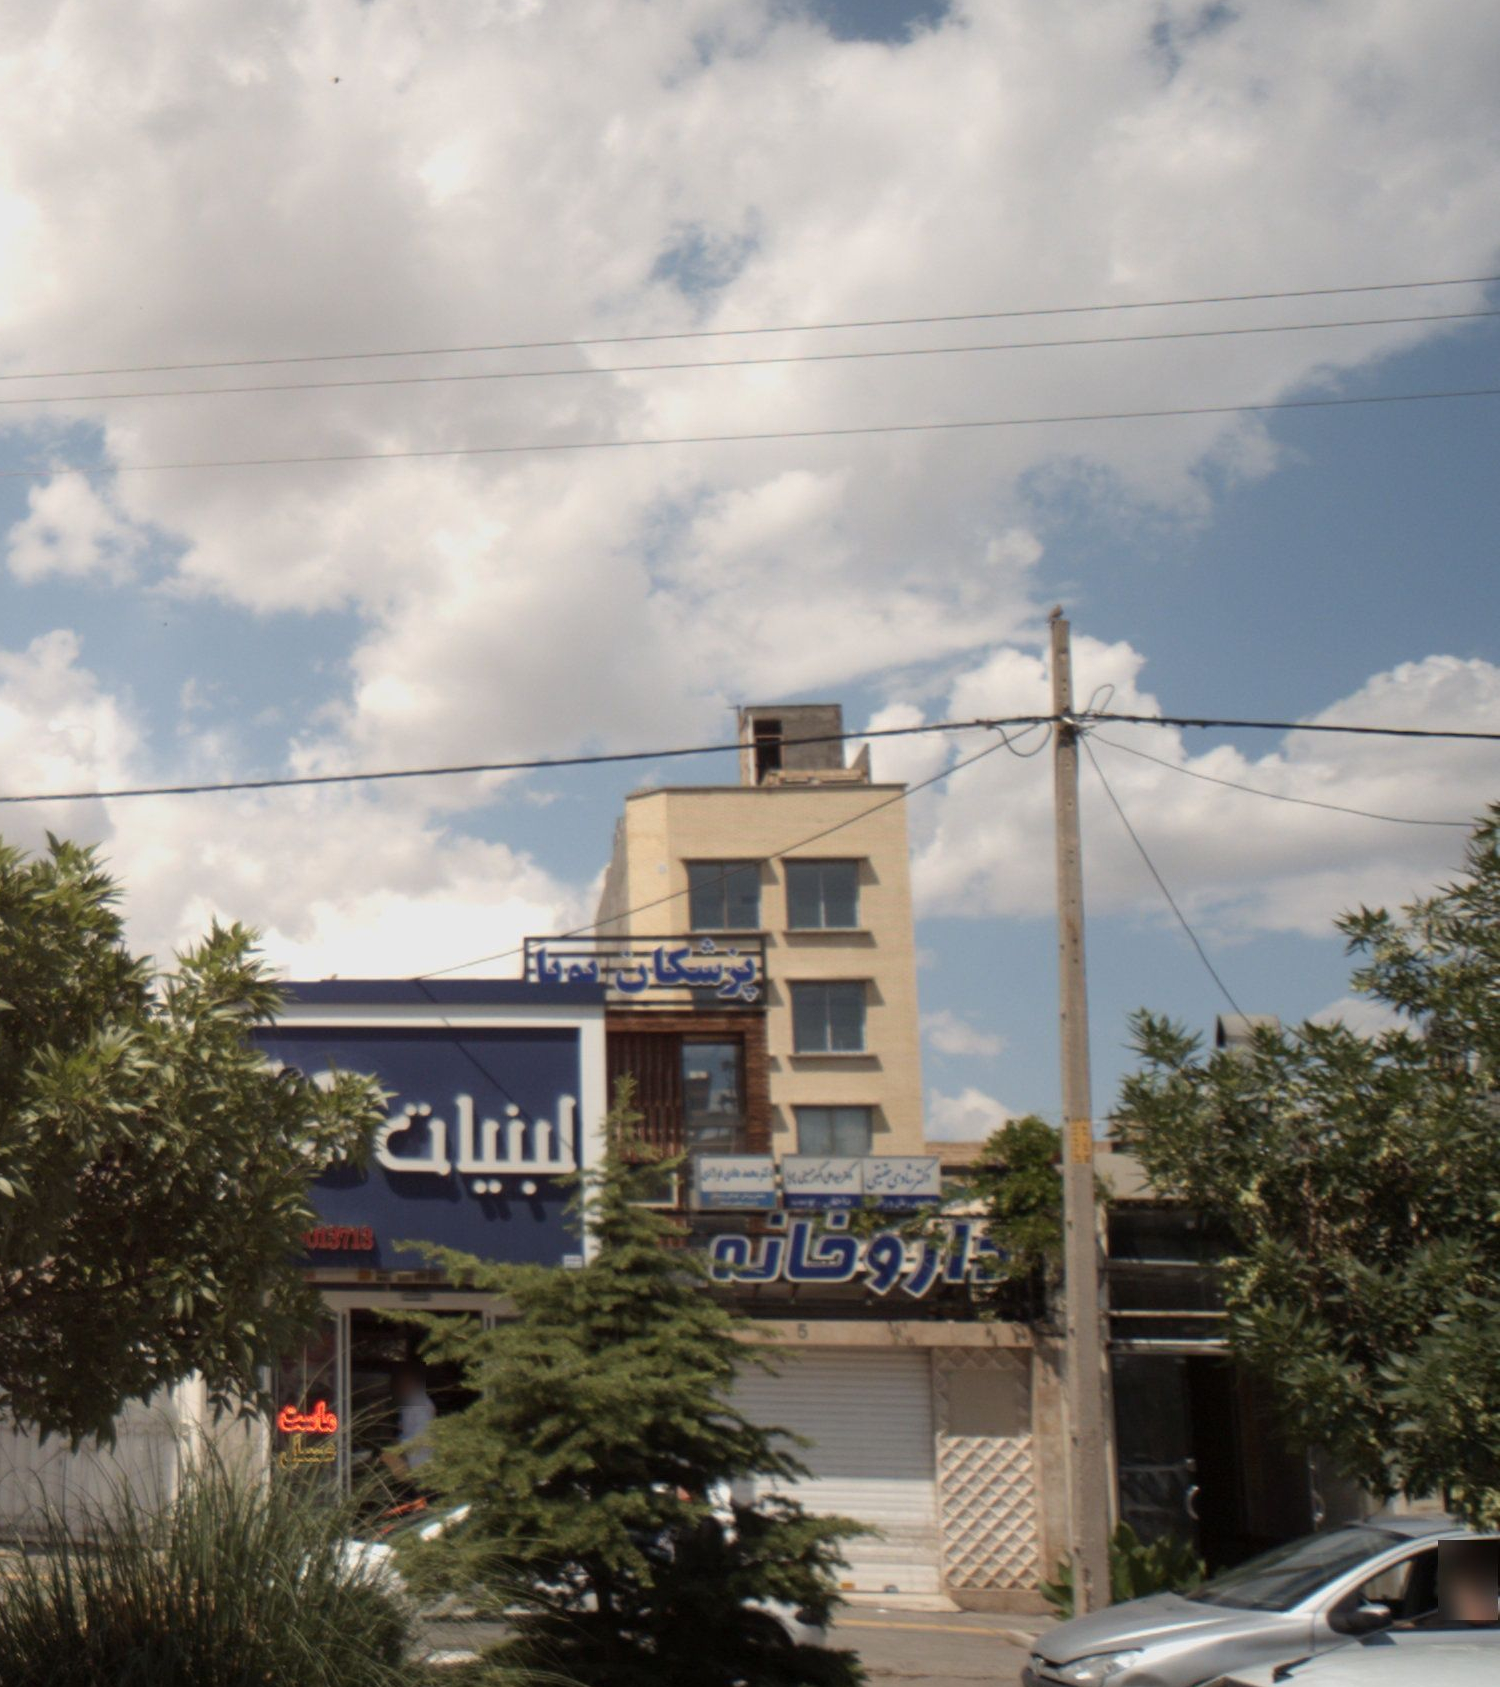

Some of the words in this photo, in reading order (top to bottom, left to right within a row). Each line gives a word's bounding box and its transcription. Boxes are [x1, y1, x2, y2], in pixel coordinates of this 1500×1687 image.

[614, 937, 759, 1002] پزشکان
[374, 1094, 576, 1195] لبنیات
[907, 1158, 938, 1193] دکتر
[710, 1210, 1011, 1298] داروخانه
[276, 1400, 338, 1433] ماست
